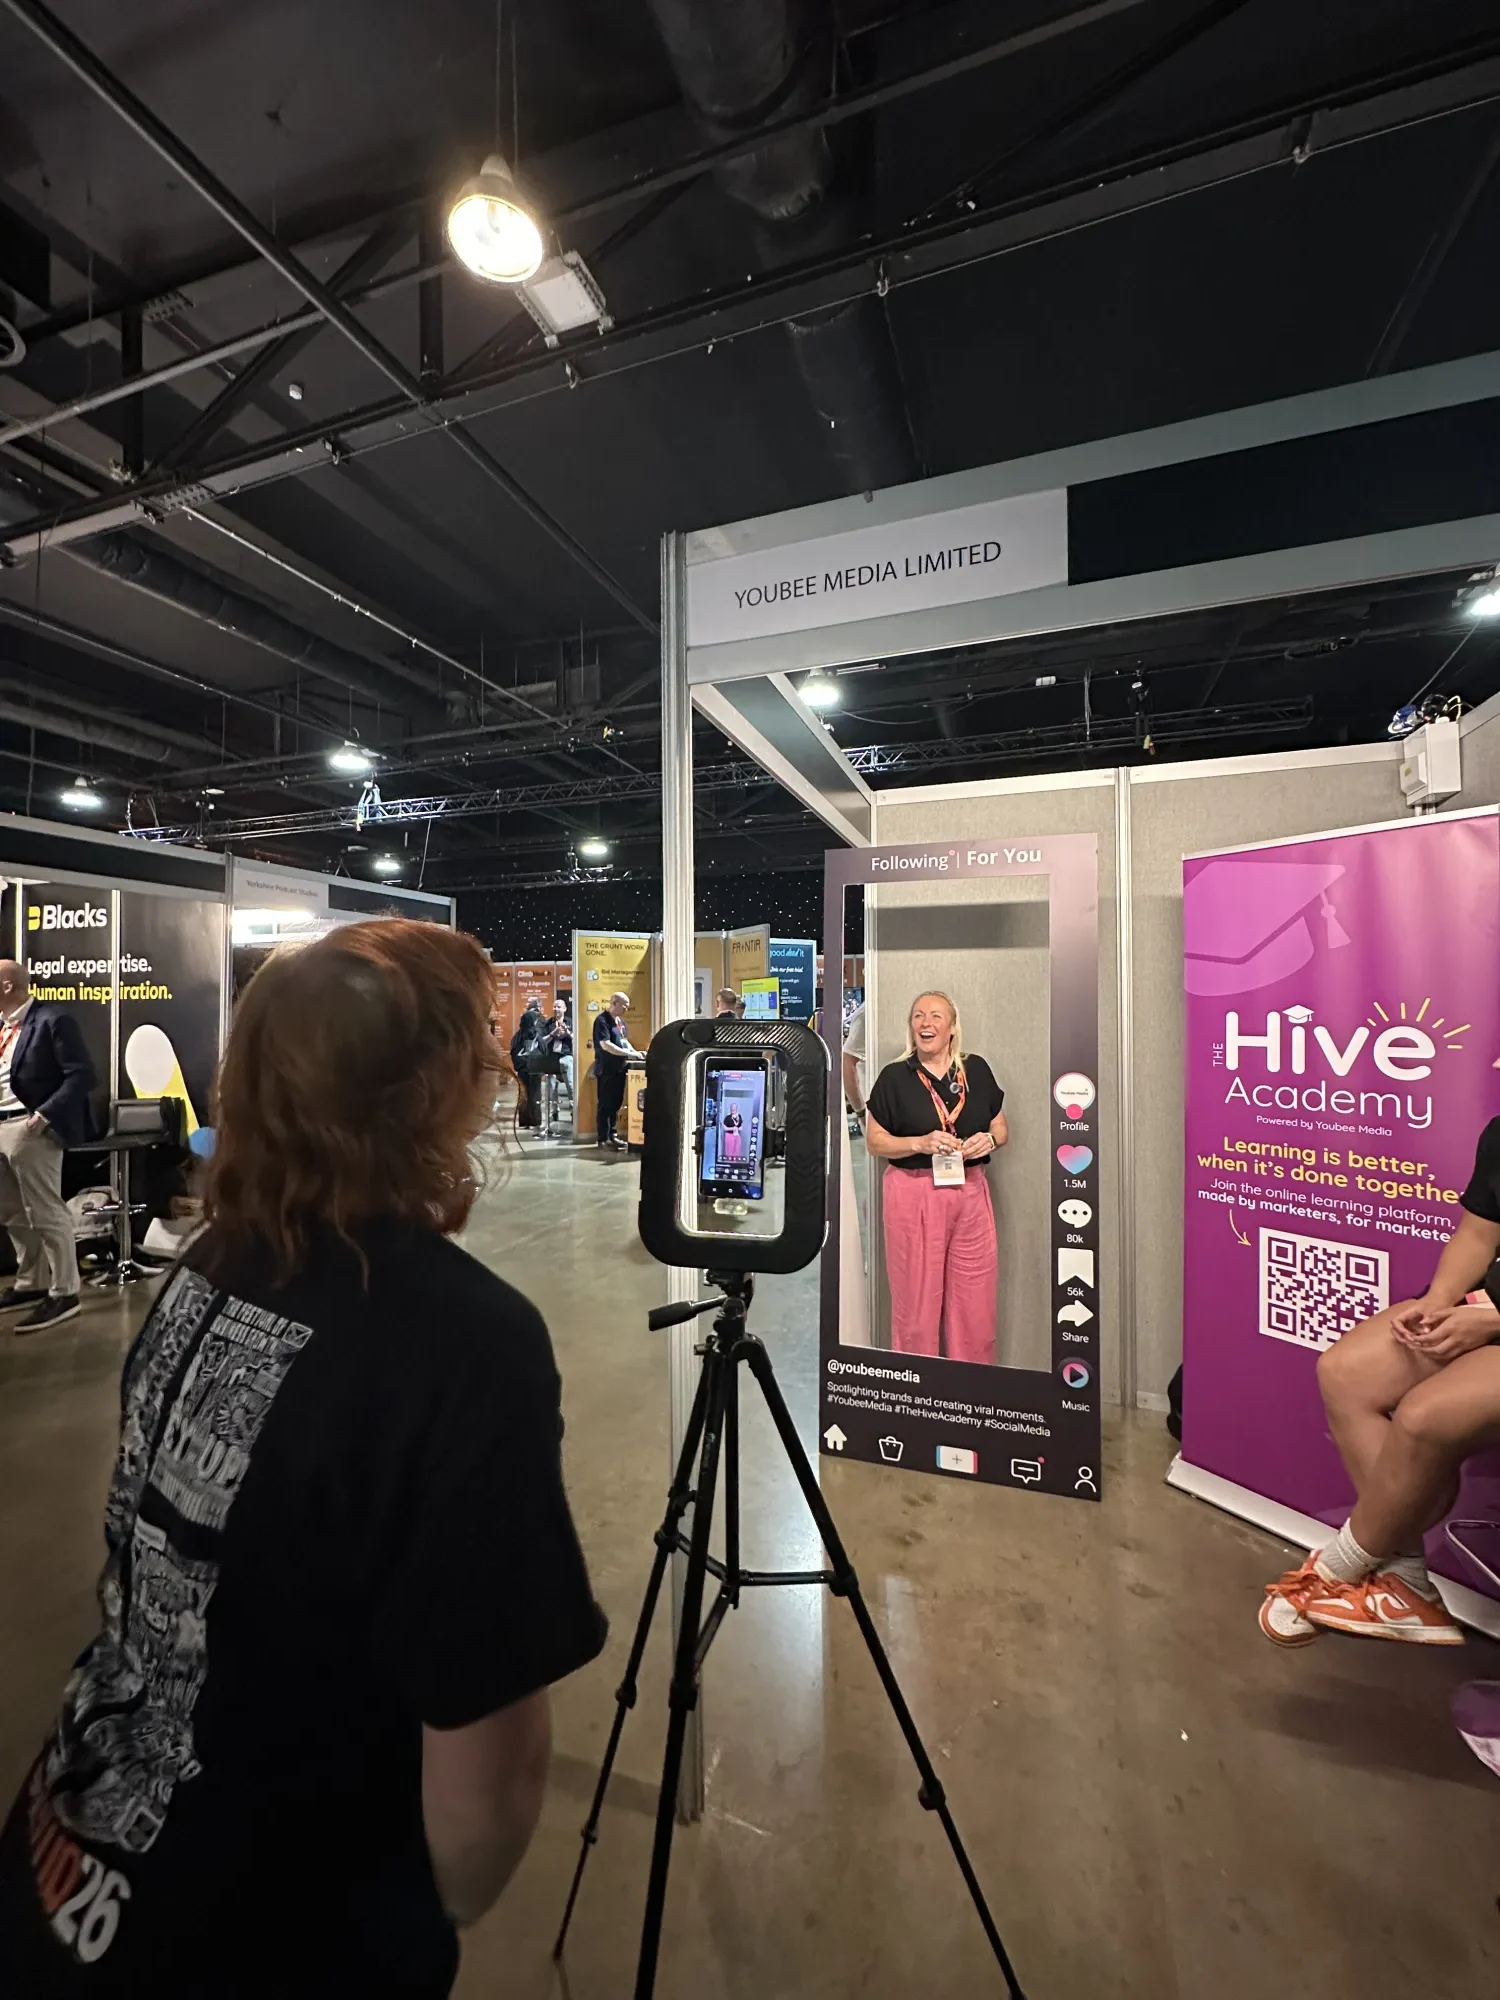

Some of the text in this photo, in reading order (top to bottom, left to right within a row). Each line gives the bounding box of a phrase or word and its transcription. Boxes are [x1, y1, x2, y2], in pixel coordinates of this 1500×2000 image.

[734, 540, 1002, 609] YOUBEE MEDIA LIMITED
[871, 848, 1042, 871] Following For You
[42, 902, 108, 930] Blacks
[27, 955, 65, 979] Legal
[28, 980, 173, 1005] Human inspiration.
[1213, 1005, 1436, 1081] THE Hive
[1224, 1076, 1432, 1129] Academy
[1060, 1121, 1090, 1131] Profile
[1256, 1115, 1392, 1136] Powered by Youbee Media
[1197, 1154, 1248, 1173] when
[1254, 1157, 1285, 1178] it's
[1290, 1165, 1348, 1188] done
[1223, 1136, 1436, 1181] Learning is better,
[1063, 1178, 1087, 1189] 1.5M
[1198, 1189, 1455, 1243] made by marketers, for markete
[1210, 1178, 1456, 1230] Join the online learning platform,
[1066, 1233, 1084, 1244] 80k
[1066, 1286, 1085, 1297] 56k
[1062, 1331, 1090, 1344] Share
[827, 1359, 920, 1384] @youbeemedia
[827, 1381, 1047, 1424] Spotlighting brands and creating viral moments.
[827, 1393, 1051, 1437] #YoubeeMedia #TheHiveAcademy #SocialMedia
[1062, 1399, 1091, 1413] Music
